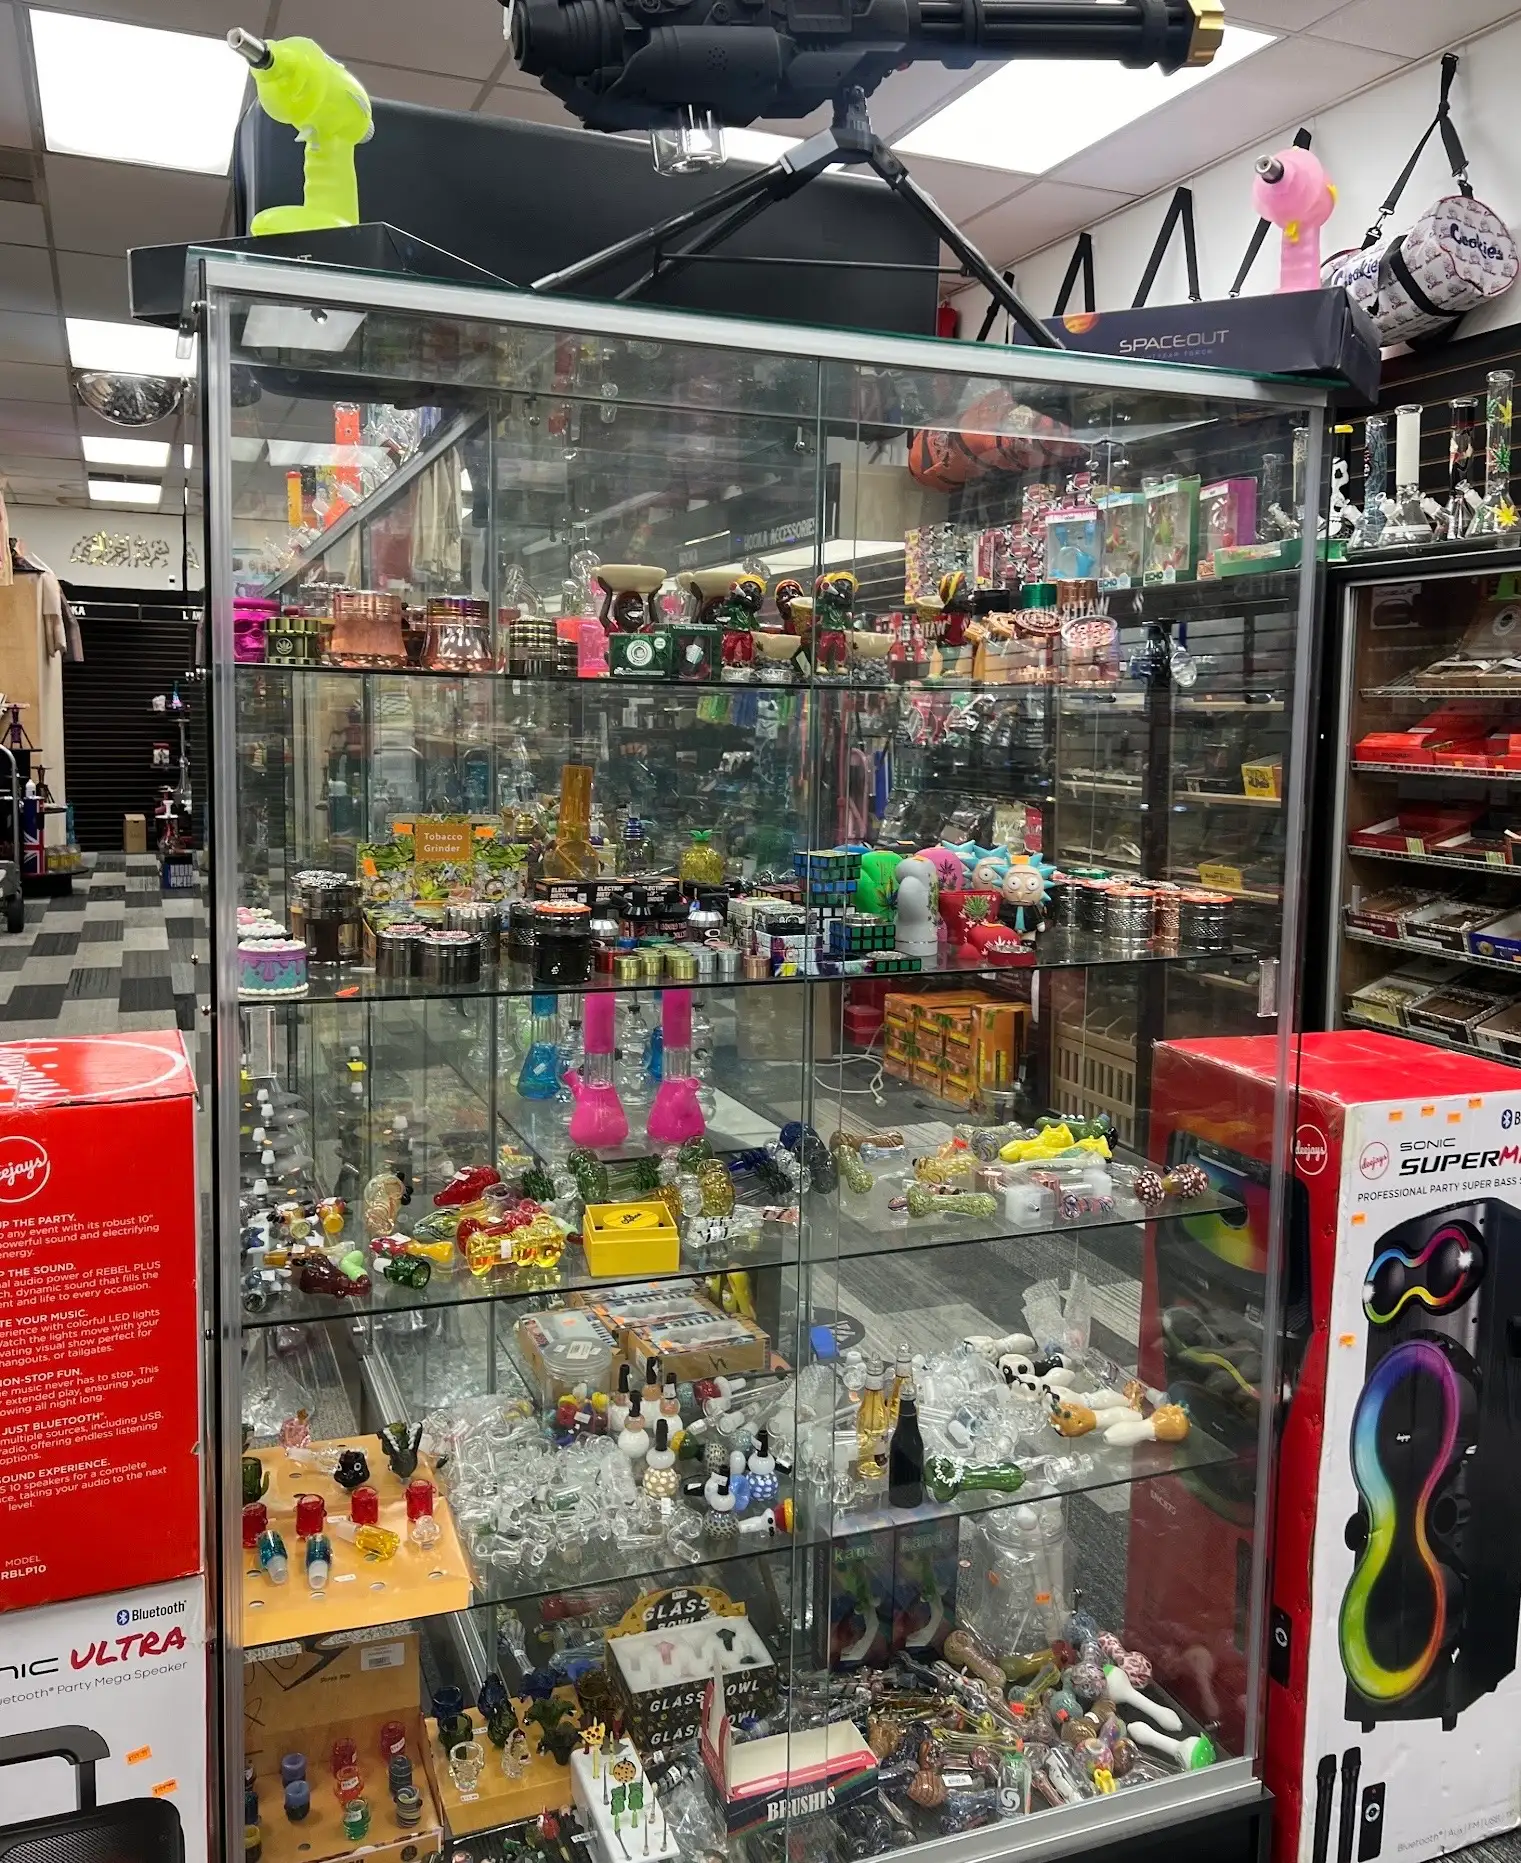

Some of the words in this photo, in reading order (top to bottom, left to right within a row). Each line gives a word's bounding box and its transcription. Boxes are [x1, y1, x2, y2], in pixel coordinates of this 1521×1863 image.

[1451, 224, 1504, 261] Cookies
[1335, 260, 1379, 287] Cookie
[1120, 330, 1229, 353] SPACEOUT
[1145, 572, 1164, 582] ECHO
[424, 832, 463, 842] Tobacco
[424, 844, 461, 853] Grinder
[1400, 1138, 1457, 1152] SONIC
[1362, 1154, 1388, 1171] deejays
[1399, 1145, 1521, 1176] SUPERM
[1358, 1188, 1427, 1202] PROFESSIONAL
[1430, 1183, 1459, 1194] PARTY
[1462, 1180, 1492, 1191] SUPER
[1494, 1177, 1517, 1187] BASS
[7, 1230, 26, 1239] any
[29, 1227, 58, 1236] event
[62, 1223, 85, 1233] with
[88, 1221, 100, 1230] its
[103, 1217, 135, 1228] robust
[13, 1218, 35, 1228] THE
[38, 1213, 76, 1225] PARTY.
[45, 1233, 78, 1245] sound
[80, 1230, 100, 1241] and
[103, 1225, 160, 1238] electrifying
[0, 1279, 11, 1289] al
[14, 1277, 43, 1287] audio
[47, 1273, 79, 1285] power
[82, 1269, 93, 1279] of
[96, 1265, 131, 1277] REBEL
[134, 1261, 161, 1271] PLUS
[8, 1268, 30, 1277] THE
[33, 1263, 77, 1274] SOUND.
[16, 1285, 61, 1298] dynamic
[65, 1280, 96, 1290] sound
[100, 1277, 120, 1286] that
[122, 1275, 139, 1283] fills
[143, 1271, 159, 1280] the
[17, 1297, 37, 1307] and
[40, 1294, 56, 1304] life
[59, 1292, 70, 1300] to
[73, 1289, 102, 1300] every
[104, 1283, 151, 1295] occasion.
[16, 1314, 48, 1326] YOUR
[51, 1309, 88, 1320] MUSIC.
[41, 1322, 64, 1333] with
[67, 1316, 106, 1329] colorful
[109, 1313, 130, 1323] LED
[133, 1309, 160, 1320] lights
[29, 1334, 47, 1344] the
[50, 1330, 78, 1342] lights
[81, 1327, 109, 1337] move
[112, 1322, 134, 1333] with
[137, 1319, 159, 1330] your
[35, 1343, 65, 1353] visual
[68, 1338, 96, 1349] show
[98, 1333, 135, 1346] perfect
[137, 1328, 152, 1338] for
[68, 1346, 114, 1359] tailgates.
[11, 1385, 43, 1396] music
[45, 1380, 74, 1391] never
[77, 1377, 95, 1386] has
[98, 1374, 108, 1382] to
[111, 1370, 136, 1381] stop.
[138, 1365, 160, 1375] This
[57, 1368, 83, 1379] FUN.
[5, 1391, 56, 1406] extended
[58, 1389, 82, 1399] play,
[85, 1381, 129, 1394] ensuring
[131, 1376, 155, 1388] your
[35, 1402, 47, 1412] all
[50, 1398, 77, 1410] night
[80, 1394, 105, 1405] long.
[0, 1432, 43, 1446] multiple
[46, 1426, 89, 1439] sources,
[91, 1415, 138, 1431] including
[2, 1424, 30, 1436] JUST
[30, 1437, 72, 1451] offering
[75, 1430, 114, 1443] endless
[116, 1422, 158, 1436] listening
[0, 1452, 42, 1465] options.
[38, 1458, 110, 1478] EXPERIENCE.
[0, 1495, 17, 1504] ce,
[20, 1488, 52, 1500] taking
[55, 1484, 78, 1495] your
[81, 1478, 110, 1490] audio
[113, 1475, 124, 1484] to
[126, 1471, 143, 1480] the
[146, 1466, 167, 1478] next
[10, 1483, 21, 1492] 10
[24, 1476, 70, 1490] speakers
[73, 1472, 88, 1481] for
[99, 1461, 147, 1477] complete
[9, 1500, 35, 1512] level.
[0, 1564, 47, 1580] RBLP10
[5, 1555, 41, 1567] MODEL
[642, 1597, 712, 1621] GLASS
[71, 1626, 187, 1670] ULTRA
[57, 1680, 92, 1695] Party
[95, 1672, 131, 1687] Mega
[135, 1661, 188, 1680] Speaker
[726, 1680, 760, 1696] OWL
[651, 1725, 701, 1746] GLAS
[767, 1787, 836, 1822] BRUSHES
